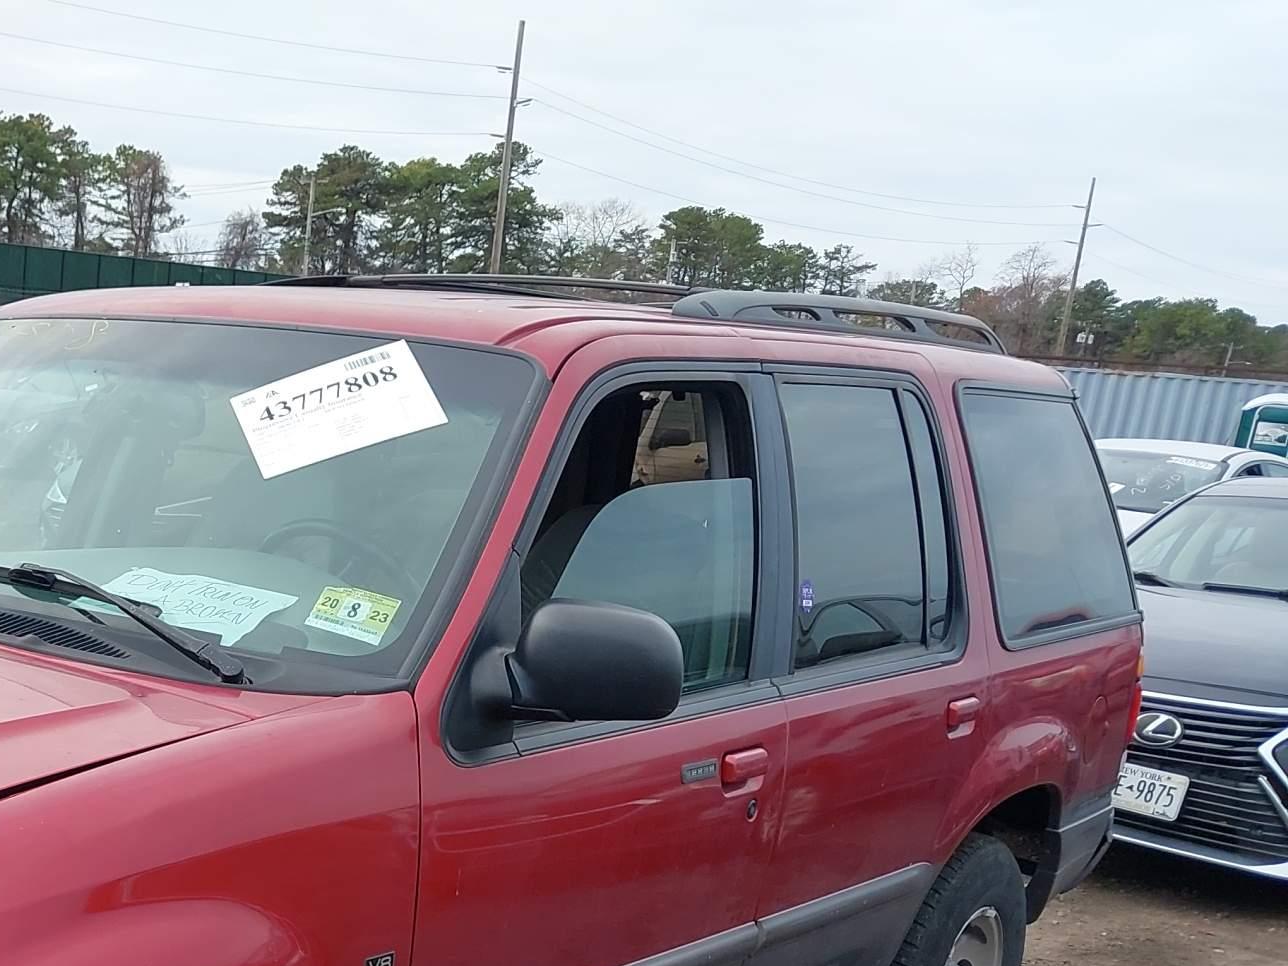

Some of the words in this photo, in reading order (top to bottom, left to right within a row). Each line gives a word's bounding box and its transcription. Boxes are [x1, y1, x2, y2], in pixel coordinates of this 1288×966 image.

[259, 365, 398, 423] 43777808
[320, 596, 340, 609] 20
[346, 602, 361, 618] 8
[369, 610, 390, 623] 23
[1134, 779, 1177, 808] 9875
